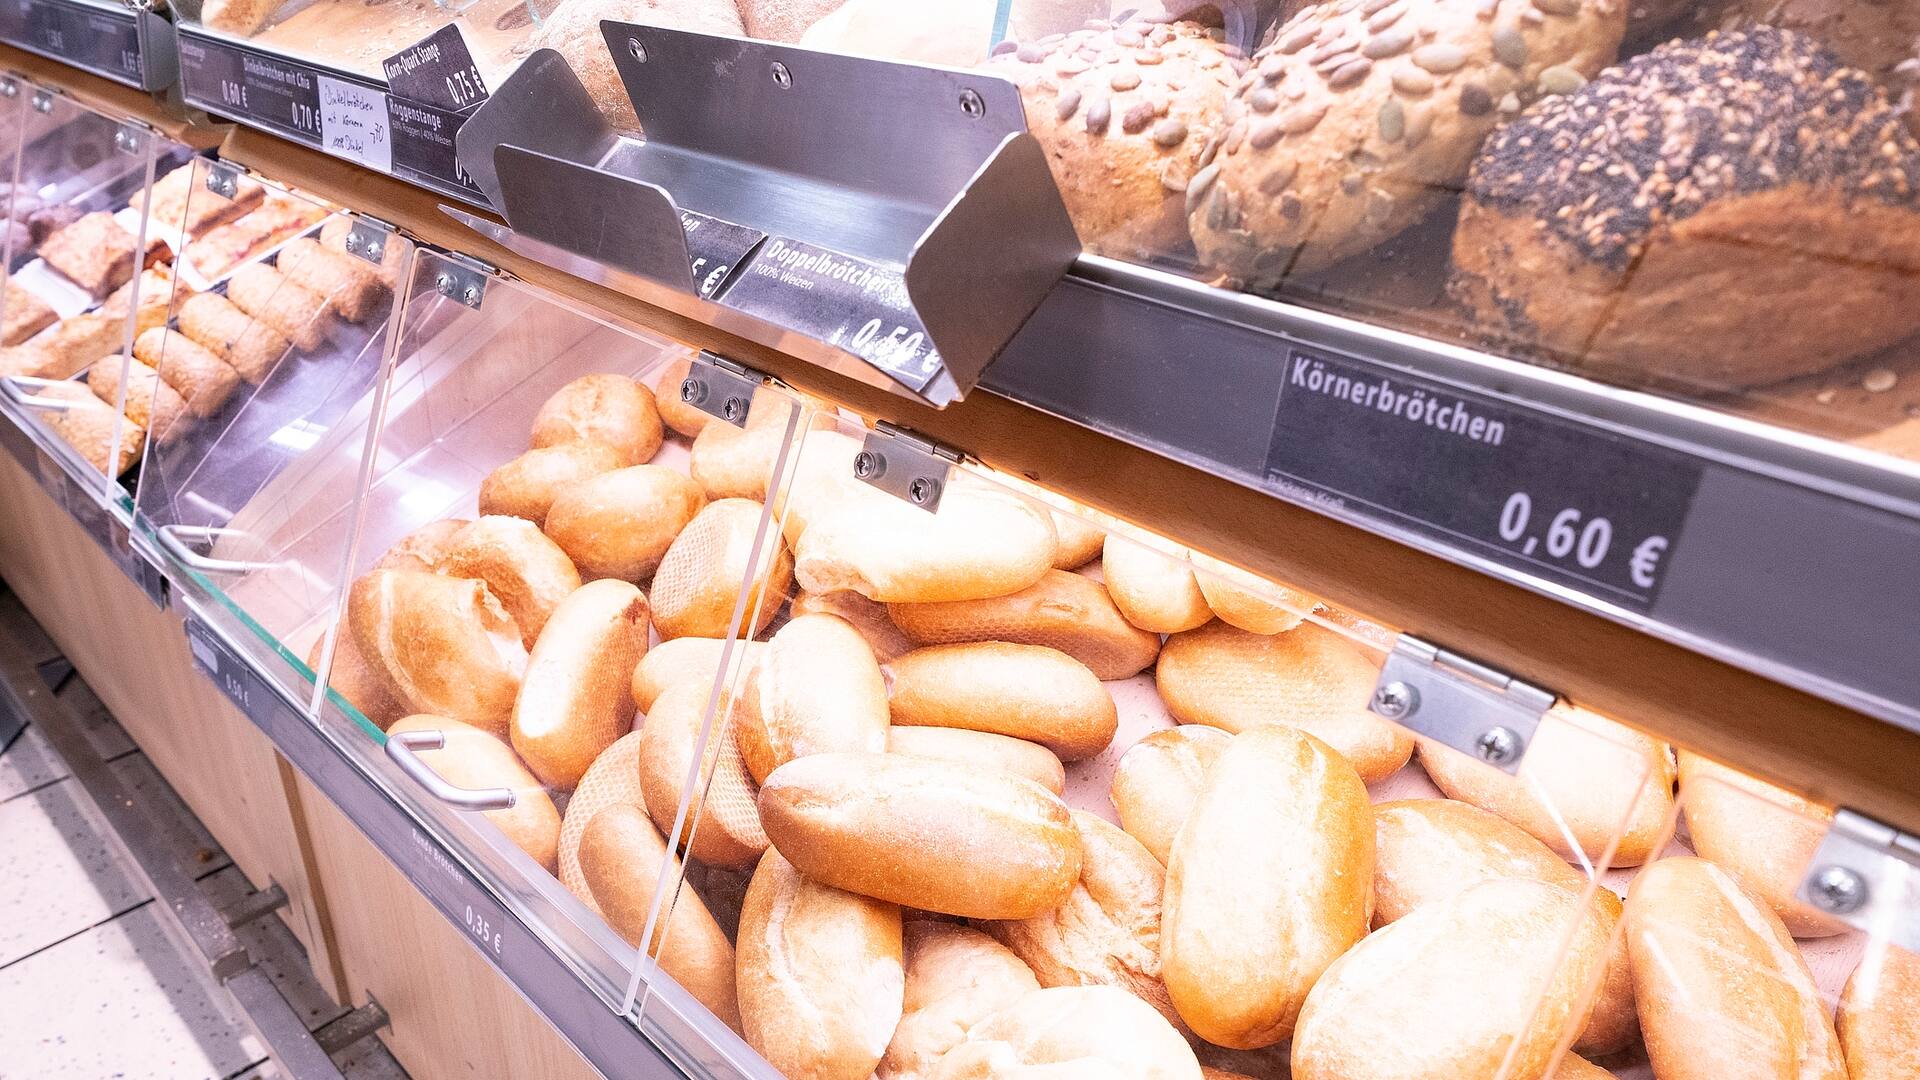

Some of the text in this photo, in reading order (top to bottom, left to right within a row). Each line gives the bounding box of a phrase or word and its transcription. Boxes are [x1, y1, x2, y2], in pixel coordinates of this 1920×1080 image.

[384, 43, 441, 80] Korn-Quark Stange
[296, 72, 310, 90] Chia
[445, 65, 486, 107] 0,75 €
[291, 101, 322, 134] 0,70 €
[388, 97, 442, 132] Roggenstange
[700, 264, 729, 294] €
[753, 262, 815, 291] 100% Weizen
[766, 239, 890, 294] Doppelbrötchen
[1290, 355, 1506, 447] Körnerbrötchen
[1498, 490, 1669, 590] 0,60 €
[433, 849, 464, 885] Brötchen
[465, 904, 502, 954] 0,35 €
